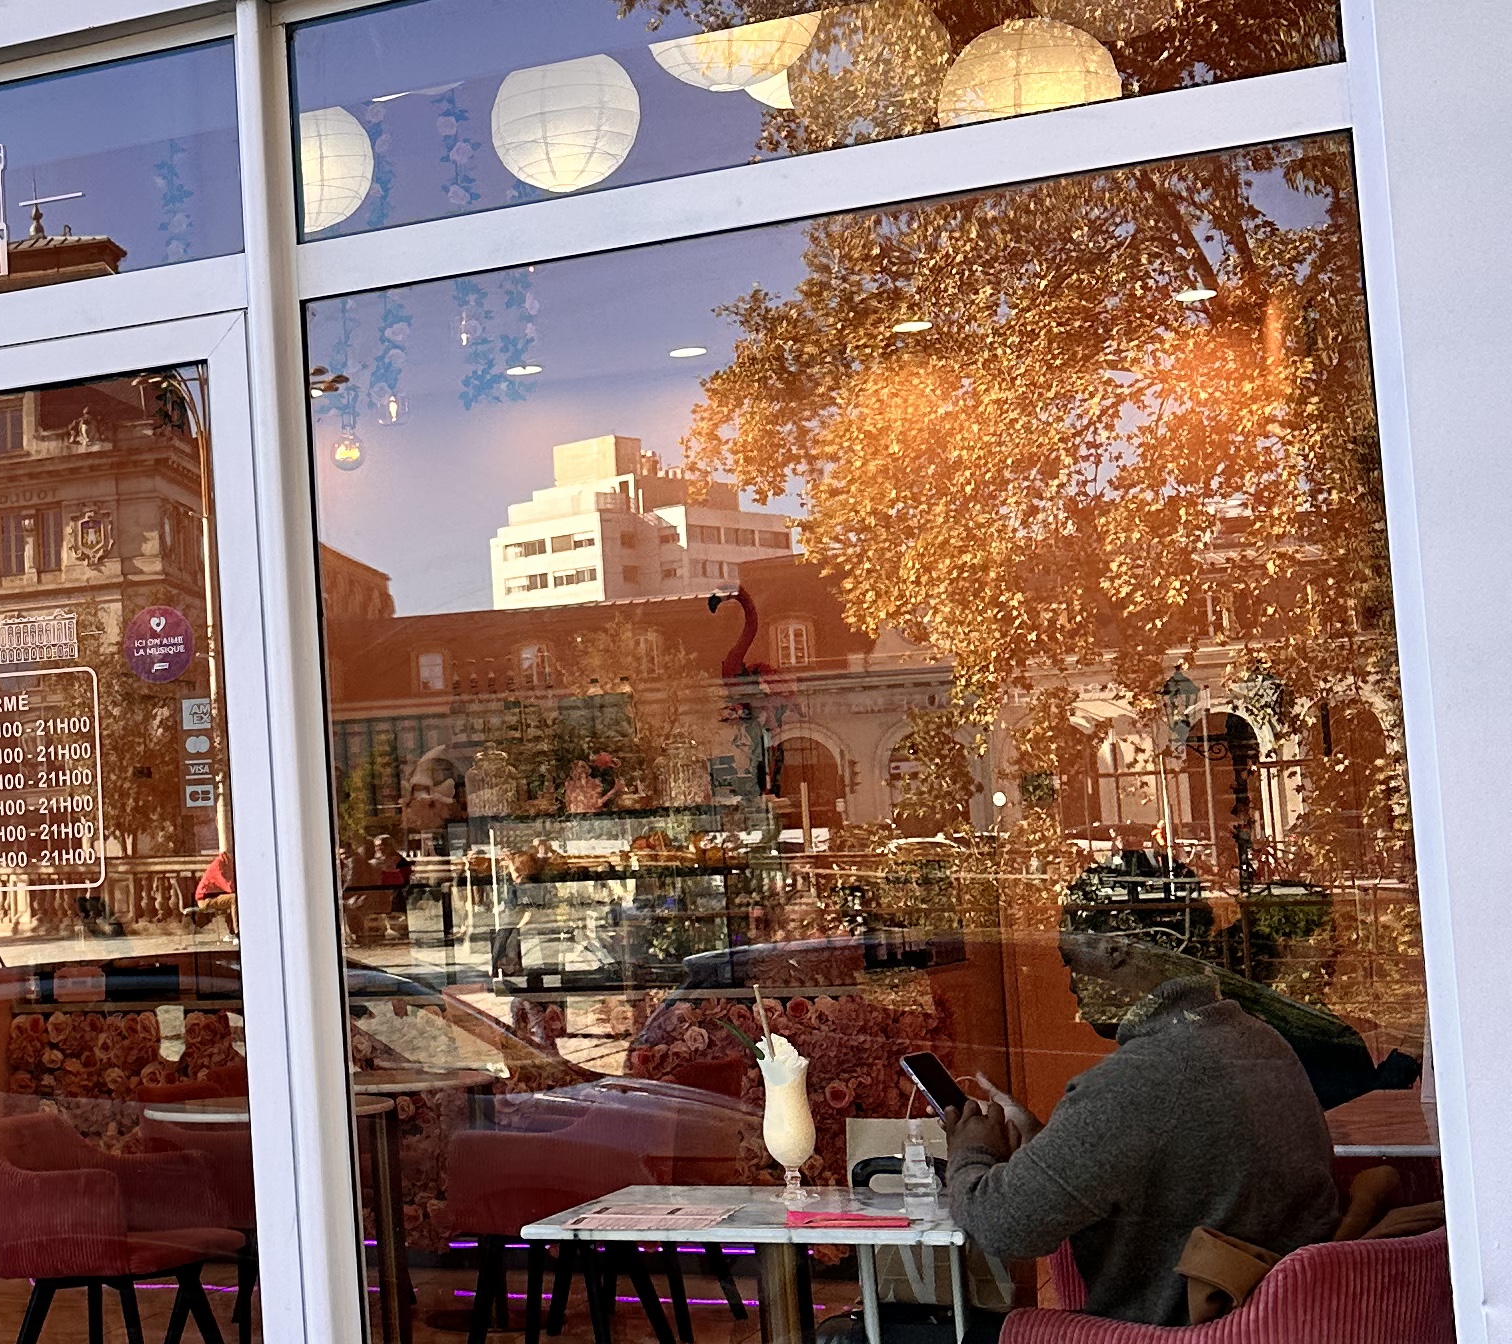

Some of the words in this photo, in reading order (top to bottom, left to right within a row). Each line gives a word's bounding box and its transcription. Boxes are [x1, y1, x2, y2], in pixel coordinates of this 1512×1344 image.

[134, 639, 146, 647] ICI
[148, 638, 161, 646] ON
[162, 636, 184, 645] AIME
[134, 648, 145, 656] LA
[147, 645, 186, 655] MUSIQUE
[36, 716, 90, 736] 21H00
[37, 743, 91, 762] 21H00
[189, 764, 210, 774] VISA
[38, 769, 92, 788] 21H00
[39, 795, 93, 814] 21H00
[189, 789, 212, 802] CB
[40, 821, 94, 840] 21H00
[40, 848, 95, 866] 21H00
